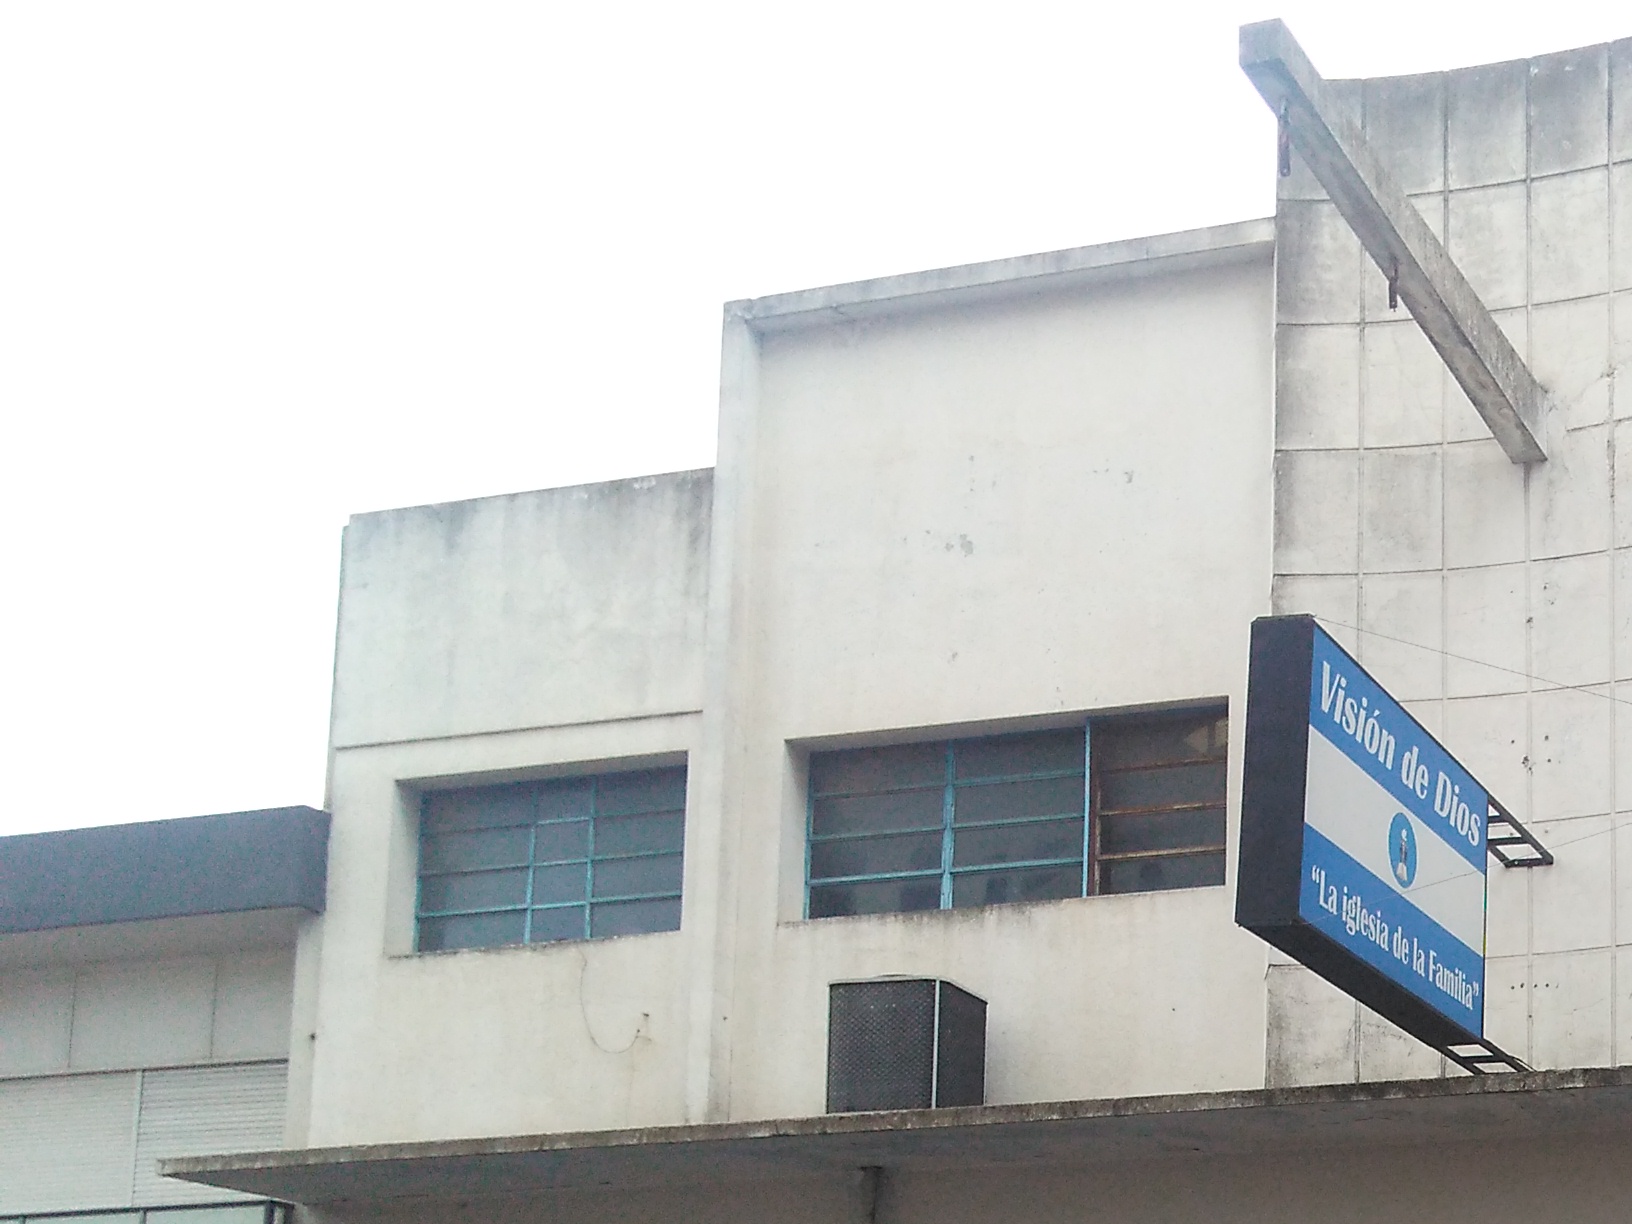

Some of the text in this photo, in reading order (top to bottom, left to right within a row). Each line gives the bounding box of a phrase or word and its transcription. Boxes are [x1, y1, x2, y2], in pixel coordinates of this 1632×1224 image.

[1320, 661, 1481, 847] Visión de Dios
[1342, 886, 1390, 951] iglesia
[1392, 926, 1410, 965] de
[1412, 937, 1425, 978] la
